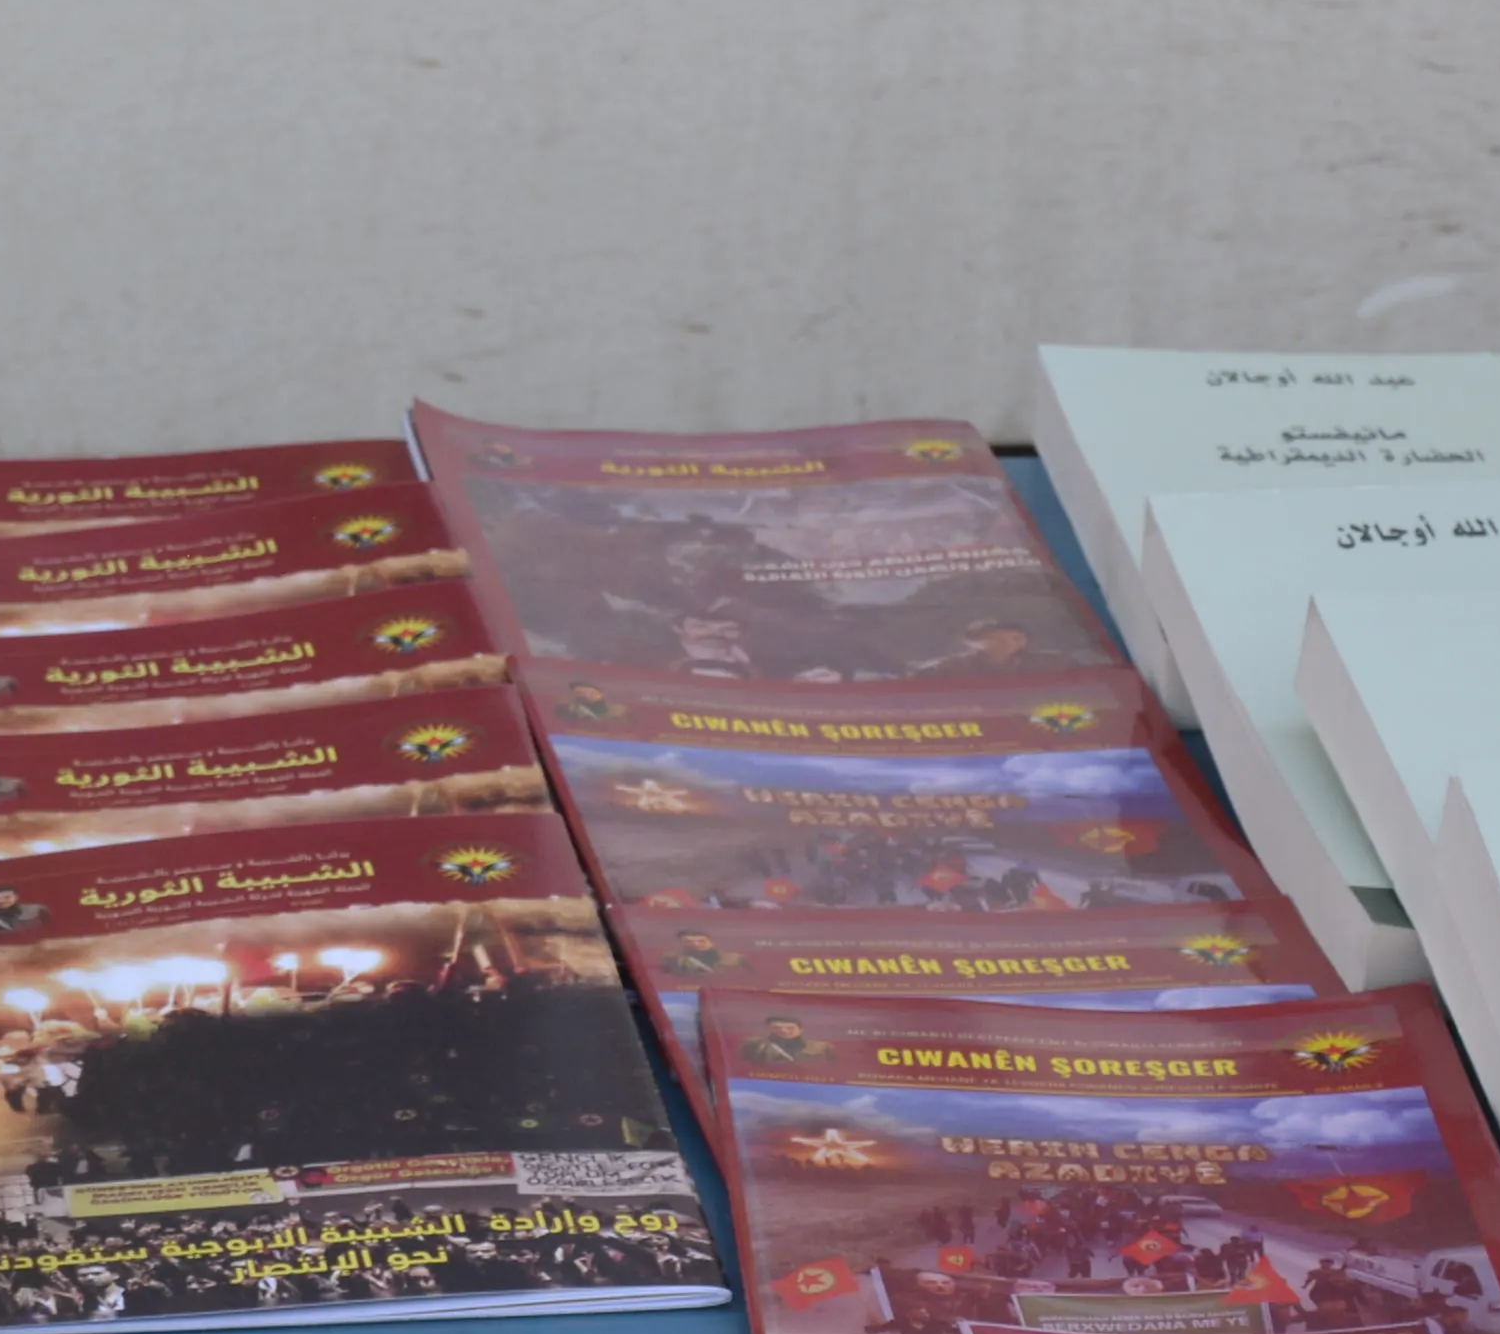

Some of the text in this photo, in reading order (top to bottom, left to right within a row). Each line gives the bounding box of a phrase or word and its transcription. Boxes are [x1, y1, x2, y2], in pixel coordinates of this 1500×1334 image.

[1205, 368, 1417, 391] عبد الله أوجالان
[1280, 424, 1407, 445] مانيفستو
[1218, 447, 1485, 466] الحضارة الديمقراطية
[1335, 514, 1436, 552] أوجالان
[1452, 518, 1499, 539] الله
[670, 711, 806, 738] CIWANÊN
[821, 718, 984, 744] ŞOREŞGER
[54, 763, 175, 792] الثورية
[216, 859, 377, 892] الشبيبة
[78, 874, 206, 909] الثورية
[788, 951, 1132, 980] CIWANÊN ŞOREŞGER
[876, 1046, 1239, 1082] CIWANÊN ŞOREŞGER
[319, 1212, 468, 1249] الشبيبة
[489, 1207, 602, 1240] وإرادة
[612, 1208, 681, 1236] روح
[386, 1244, 452, 1271] نحو
